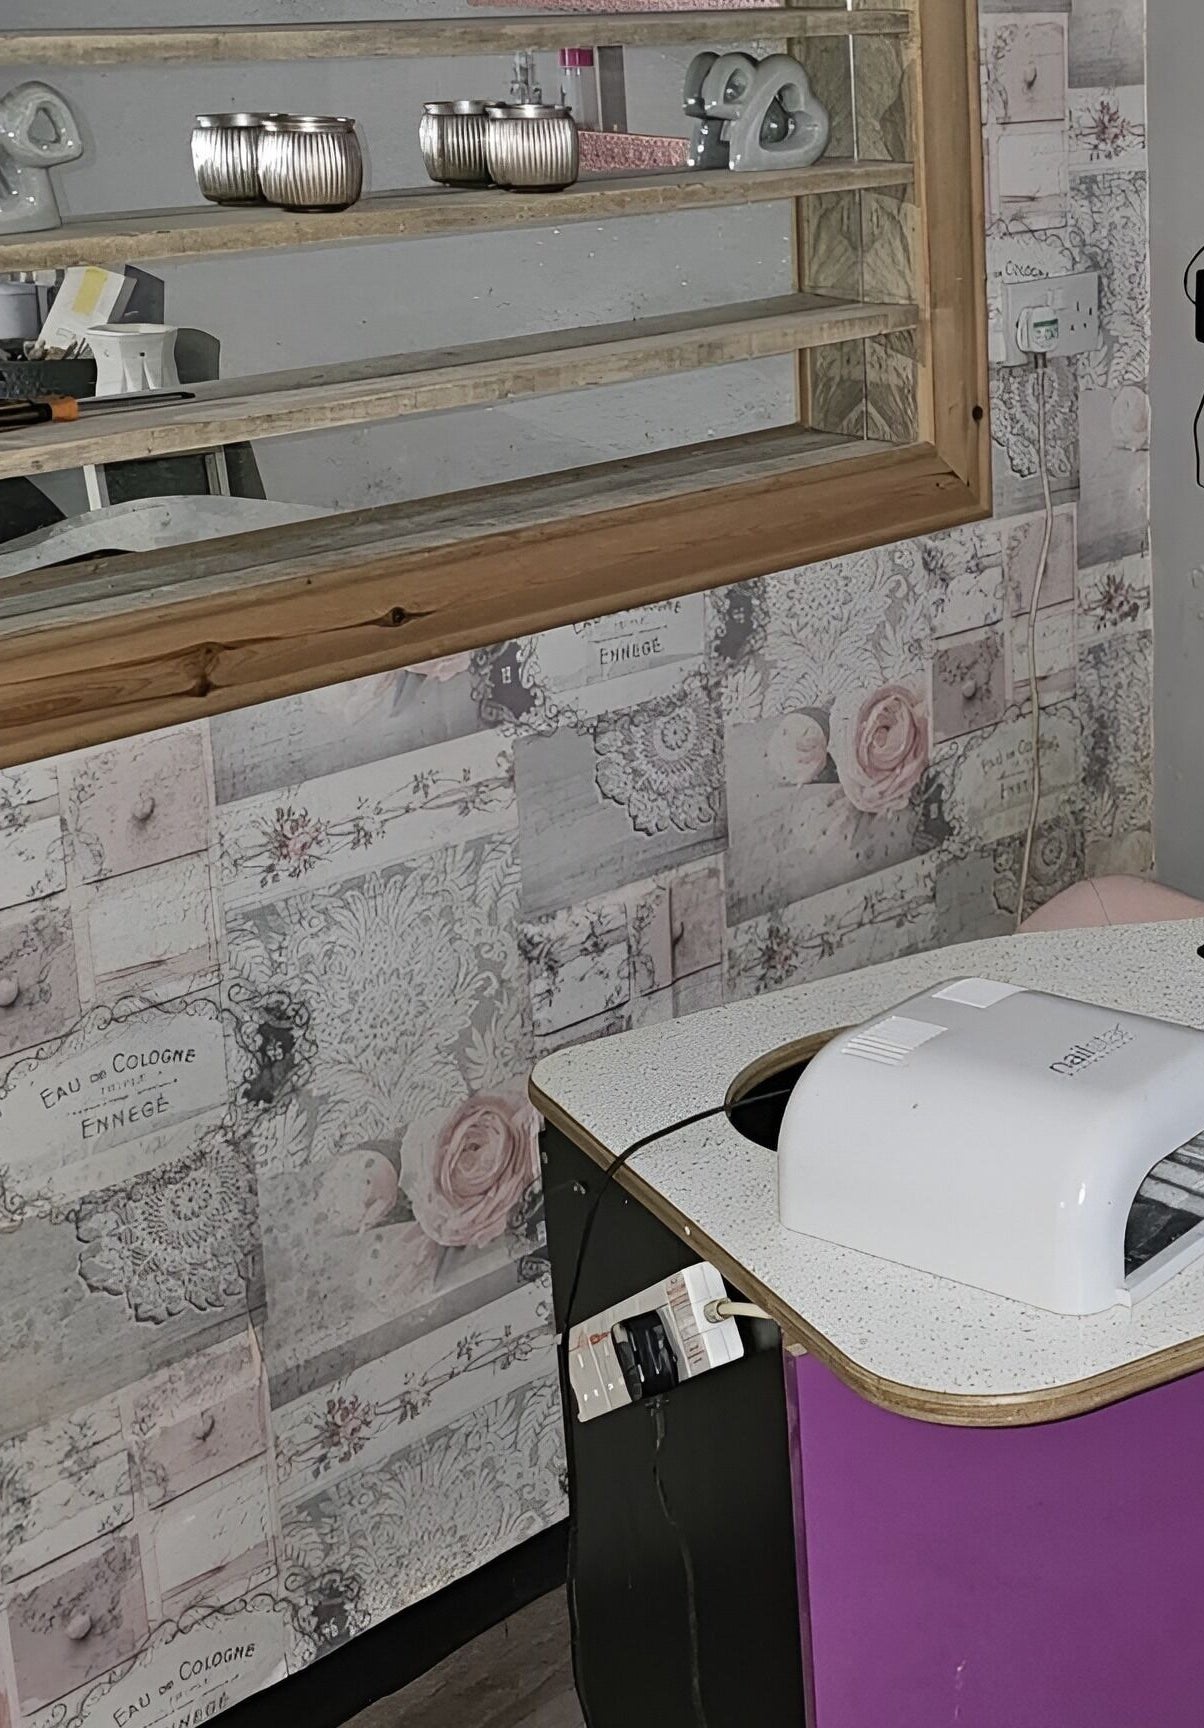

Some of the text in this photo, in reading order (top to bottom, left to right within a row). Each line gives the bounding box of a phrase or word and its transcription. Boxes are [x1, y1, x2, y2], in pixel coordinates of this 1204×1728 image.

[40, 1078, 81, 1109] EAU
[112, 1049, 196, 1073] COLOGNE
[112, 1693, 151, 1728] EAU
[179, 1643, 256, 1680] COLOGNE
